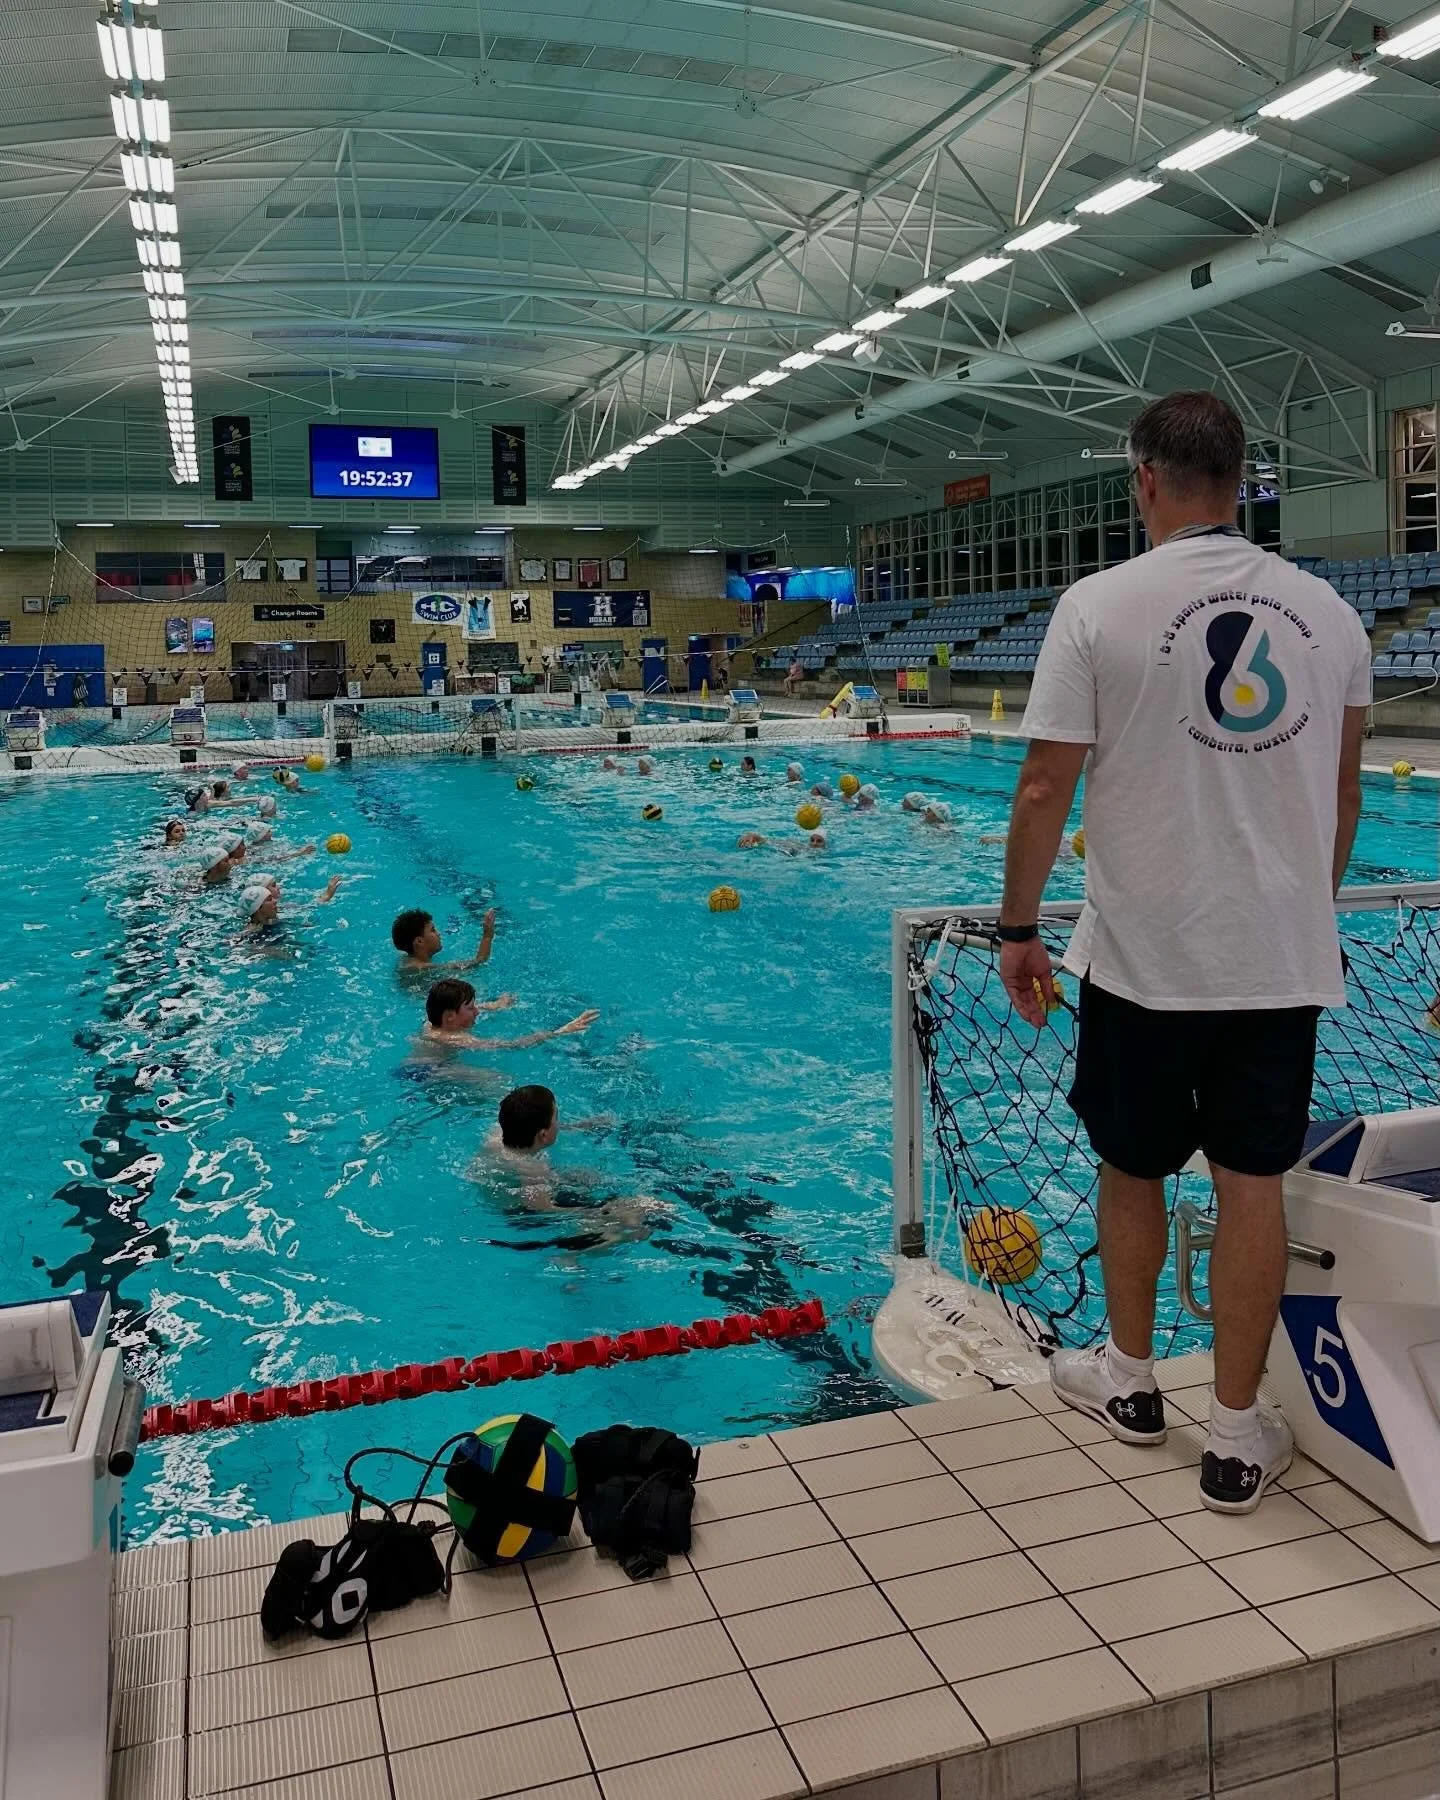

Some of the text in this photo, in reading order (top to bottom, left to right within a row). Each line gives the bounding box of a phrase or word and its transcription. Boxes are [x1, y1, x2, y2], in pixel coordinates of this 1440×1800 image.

[339, 470, 413, 487] 19:52:37
[271, 610, 295, 618] Change
[419, 610, 458, 621] SWIM CLUB
[1171, 598, 1206, 630] sports
[1207, 589, 1248, 604] water
[1251, 594, 1282, 611] polo
[1283, 608, 1313, 639] camp
[1188, 712, 1309, 754] canberra, australia
[1313, 1325, 1347, 1408] 5
